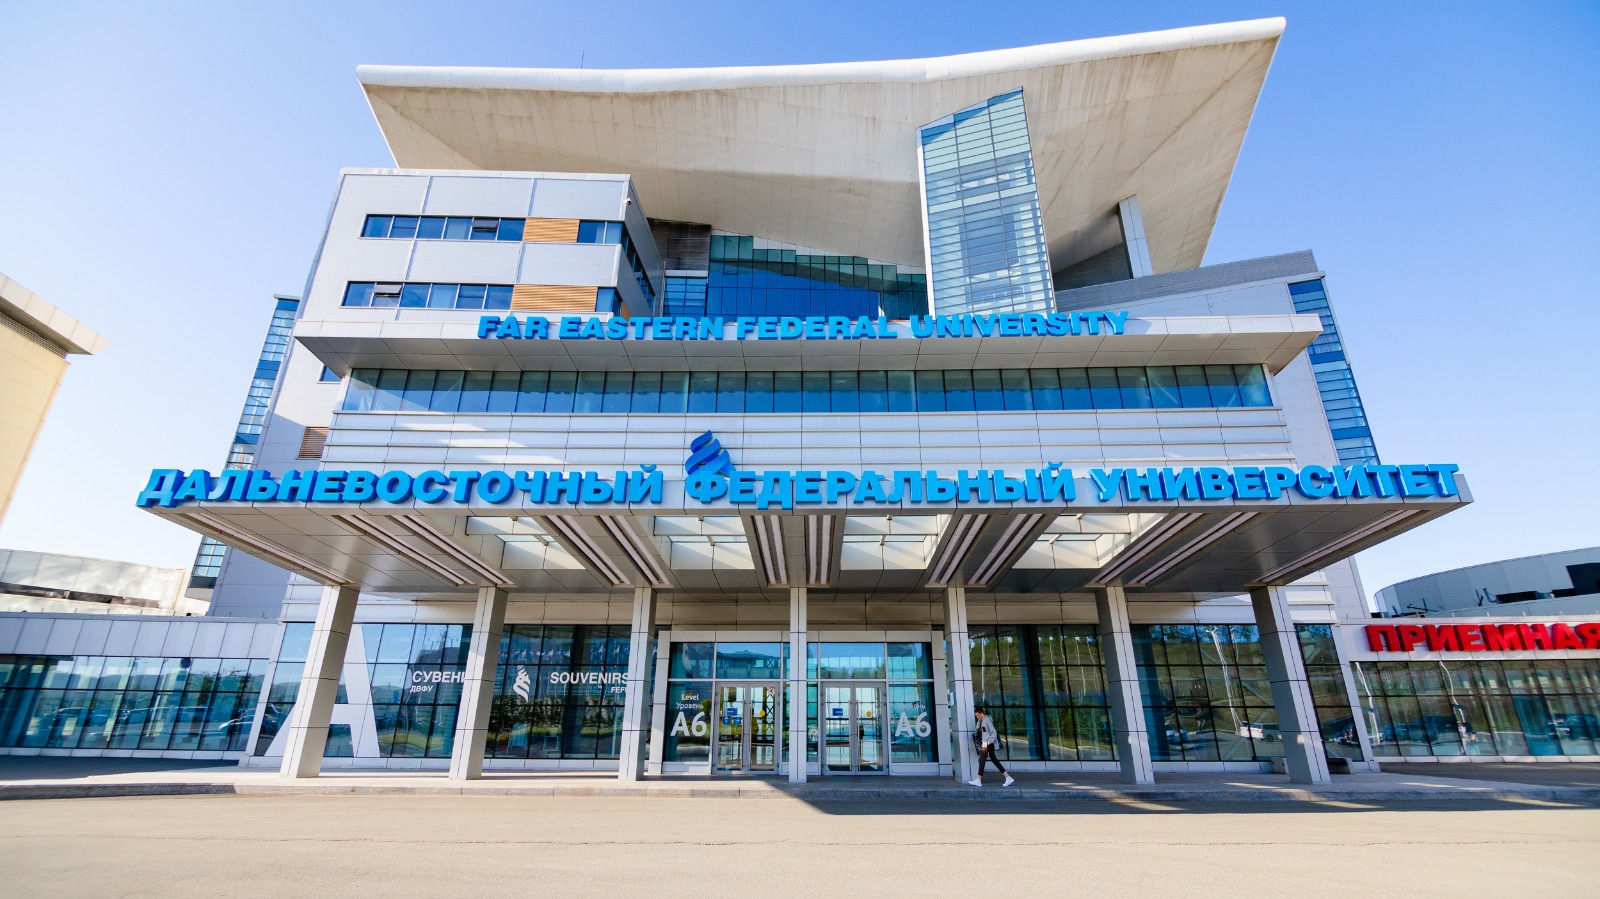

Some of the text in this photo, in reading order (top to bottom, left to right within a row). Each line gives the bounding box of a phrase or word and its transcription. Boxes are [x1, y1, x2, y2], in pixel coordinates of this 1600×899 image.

[477, 310, 1130, 341] FAR EASTERN FEDERAL UNIVERSITY
[136, 460, 1460, 511] ДАЛЬНЕВОСТОЧНЫЙ ФЕДЕРАЛЬНЫЙ УНИВЕРСИТЕТ
[1364, 622, 1600, 652] ПРИЕМНАЯ
[409, 685, 433, 693] ДВФУ
[681, 693, 700, 701] Level
[676, 701, 704, 710] Уровень
